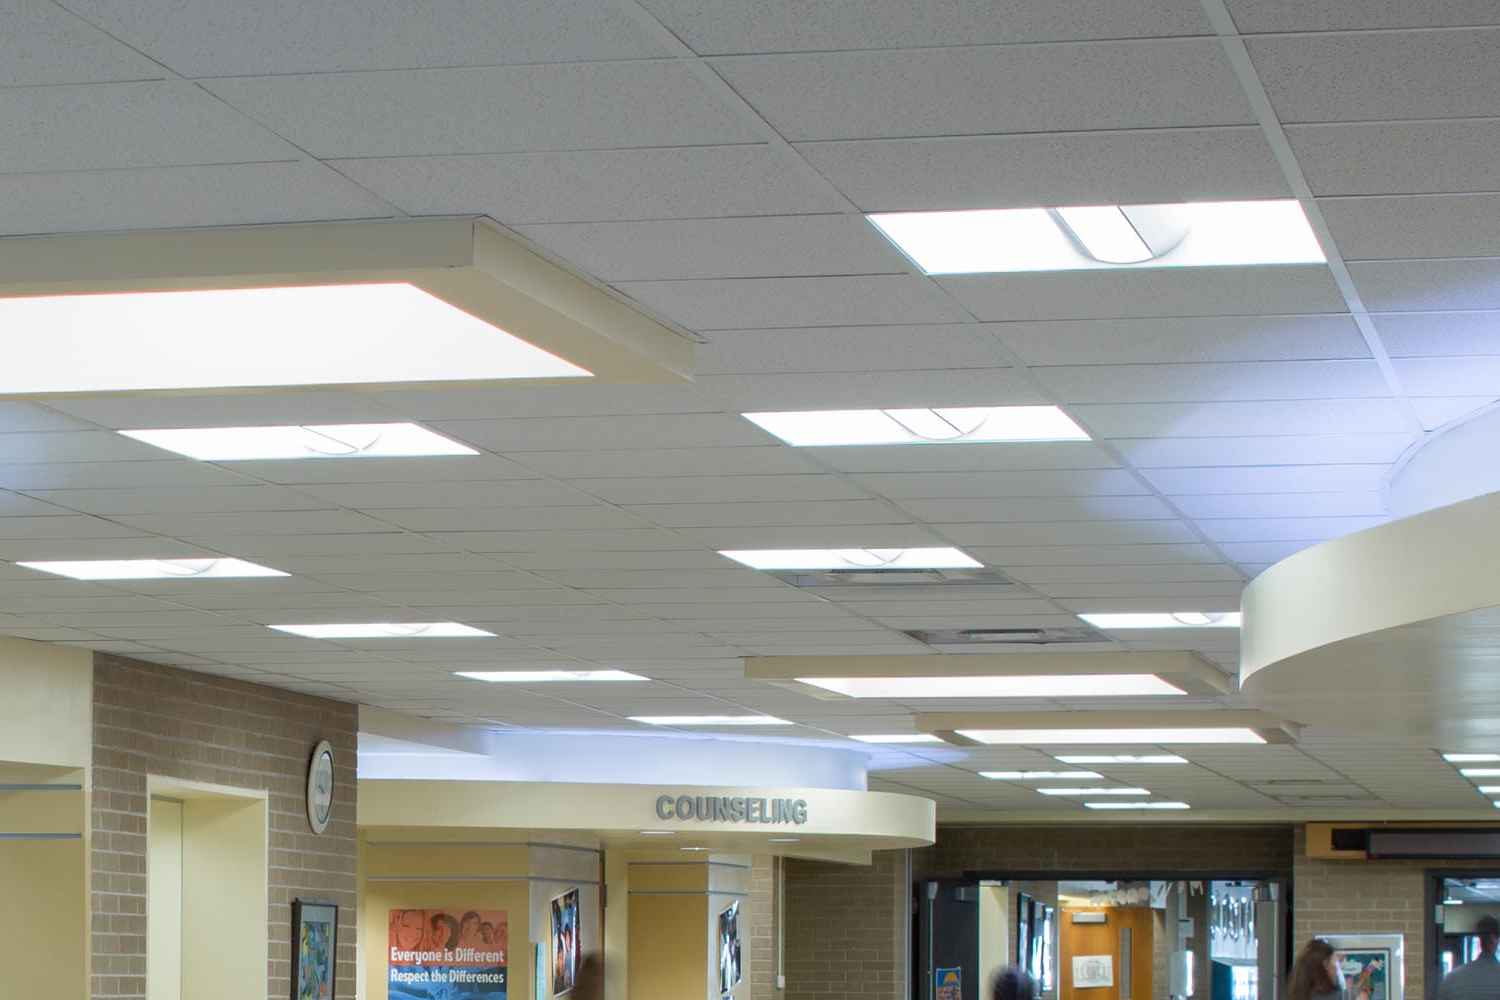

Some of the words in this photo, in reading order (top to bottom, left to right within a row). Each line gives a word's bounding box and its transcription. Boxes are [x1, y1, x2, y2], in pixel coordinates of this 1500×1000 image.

[656, 795, 808, 825] COUNSELING
[390, 946, 442, 965] Everyone
[444, 948, 453, 961] is
[455, 947, 504, 962] Different
[390, 968, 430, 985] Respect
[431, 970, 447, 983] the
[449, 969, 504, 984] Differences
